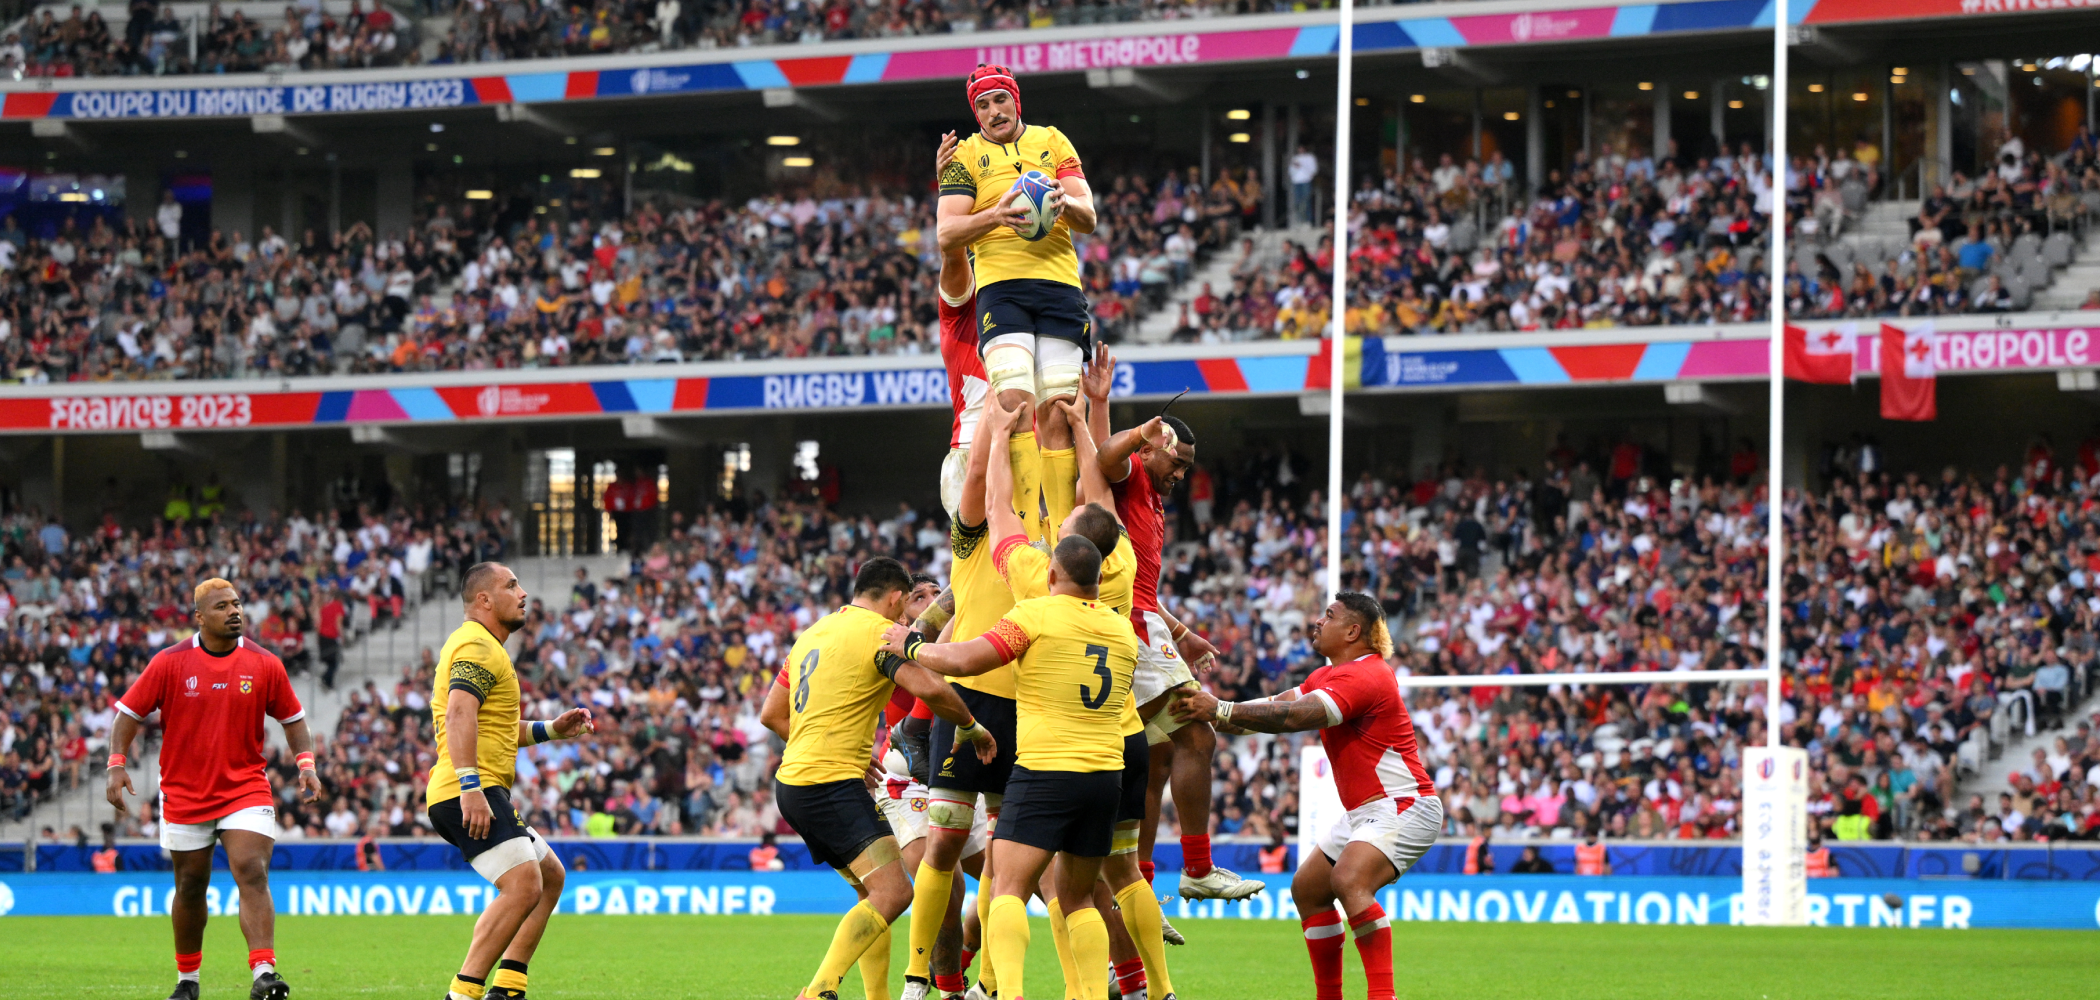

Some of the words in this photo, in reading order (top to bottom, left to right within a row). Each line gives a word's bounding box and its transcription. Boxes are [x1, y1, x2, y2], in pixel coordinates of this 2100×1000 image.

[158, 89, 191, 117] DU
[196, 86, 285, 116] MONDE
[331, 82, 407, 112] RUGBY
[409, 79, 465, 108] 2023
[763, 371, 866, 409] RUGBY
[873, 368, 952, 405] WOR
[180, 393, 252, 428] 2023
[794, 648, 820, 714] 8
[1079, 643, 1113, 710] 3
[1385, 888, 1709, 925] INNOVATION
